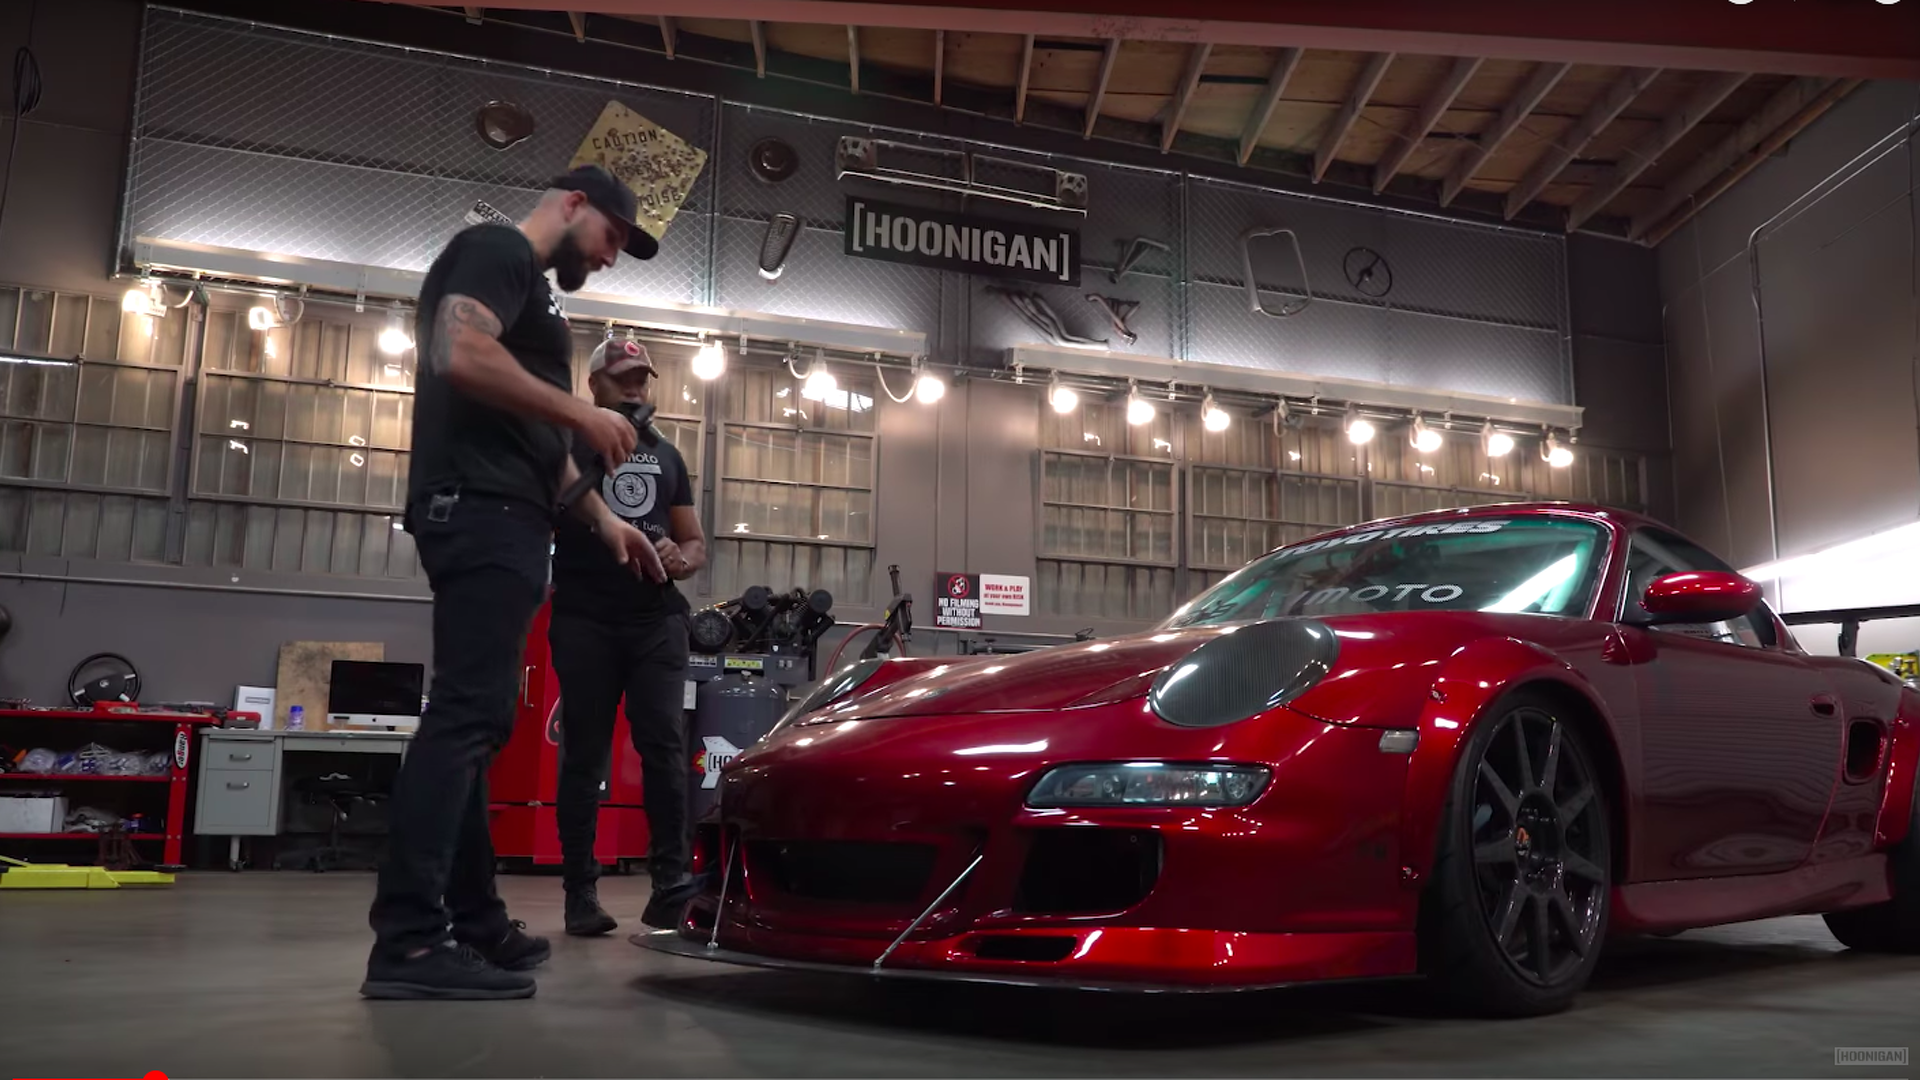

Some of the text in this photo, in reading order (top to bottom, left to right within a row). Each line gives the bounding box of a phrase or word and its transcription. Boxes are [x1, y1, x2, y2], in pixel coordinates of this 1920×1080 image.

[593, 129, 658, 150] CAUTION
[853, 202, 1070, 281] [HOONIGAN]
[642, 520, 665, 535] tunin
[1380, 520, 1511, 540] TIRES
[985, 583, 1002, 592] WORK
[938, 598, 948, 607] NO
[950, 598, 979, 608] FILMING
[942, 607, 975, 617] WITHOUT
[937, 616, 980, 627] PERMISSION
